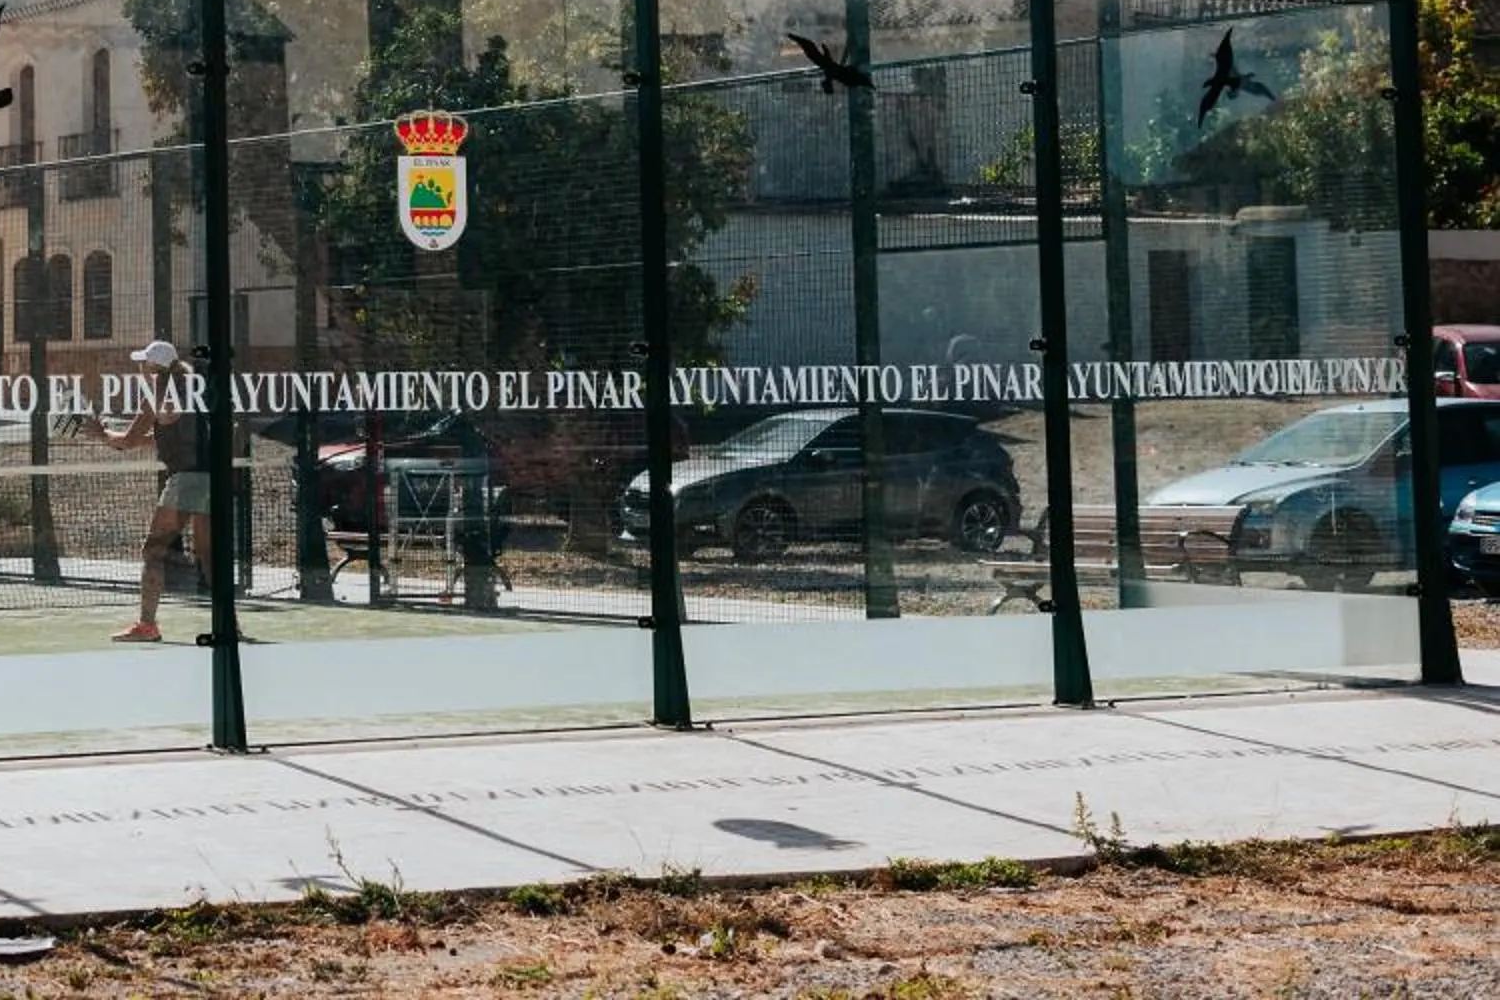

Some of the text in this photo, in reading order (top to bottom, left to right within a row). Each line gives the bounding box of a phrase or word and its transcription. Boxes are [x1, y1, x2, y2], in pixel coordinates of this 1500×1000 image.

[47, 374, 94, 415] EL
[101, 372, 209, 415] PINAR
[497, 371, 540, 409] EL
[546, 371, 645, 409] PINAR
[910, 364, 949, 402] EL
[955, 362, 1045, 401] PINAR
